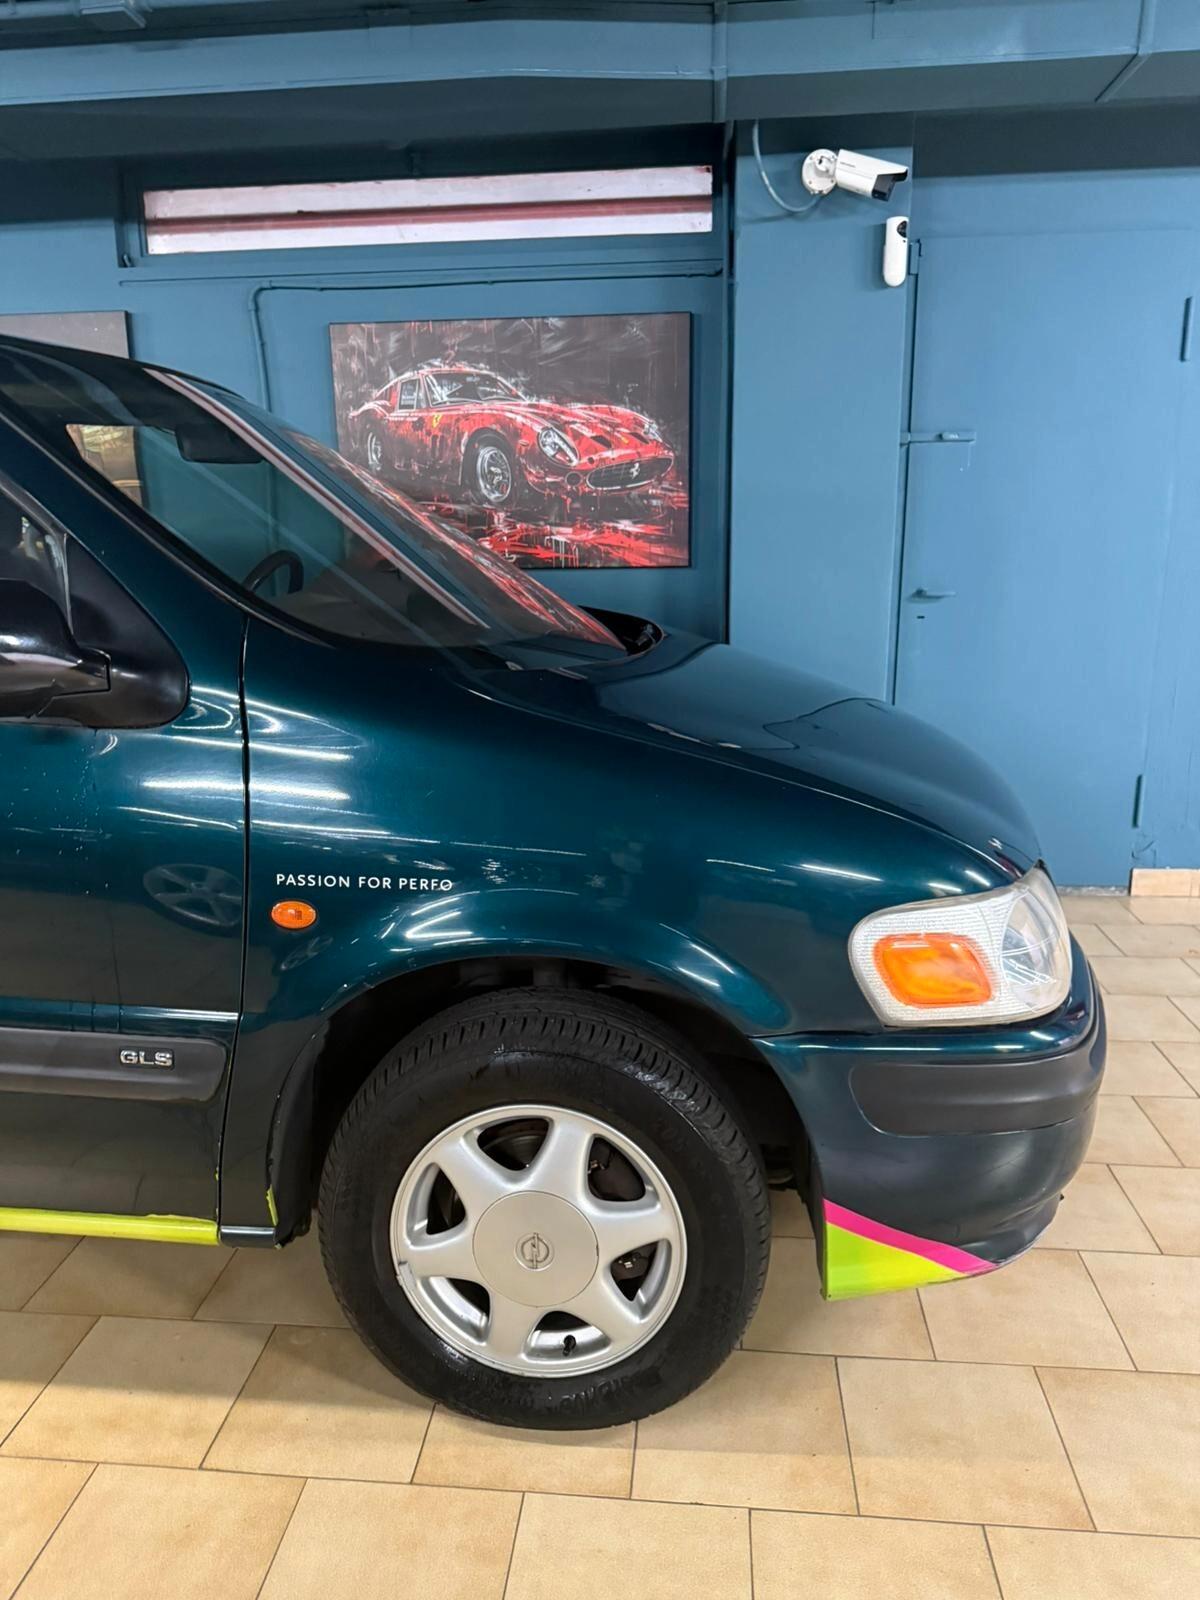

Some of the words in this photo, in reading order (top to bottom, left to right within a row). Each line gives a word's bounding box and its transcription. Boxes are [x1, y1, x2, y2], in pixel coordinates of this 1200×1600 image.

[276, 873, 350, 888] PASSION
[358, 876, 392, 889] FOR
[399, 878, 453, 891] PERFO
[120, 1050, 173, 1067] GLS
